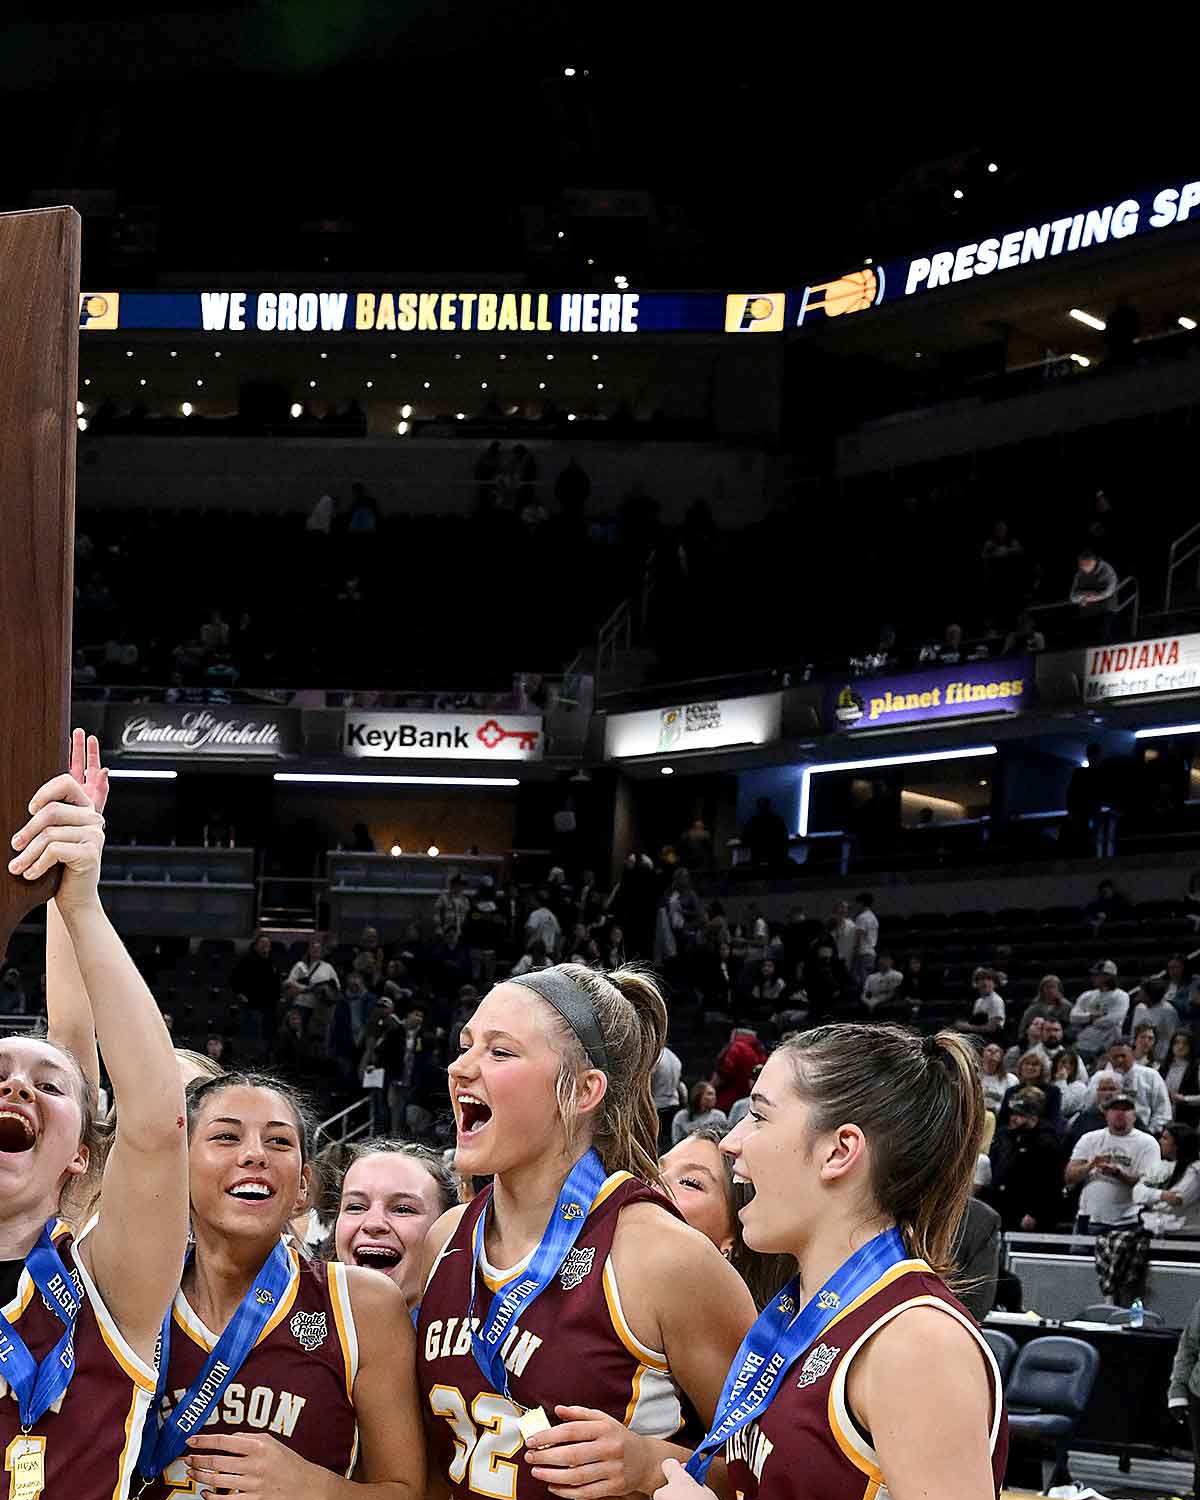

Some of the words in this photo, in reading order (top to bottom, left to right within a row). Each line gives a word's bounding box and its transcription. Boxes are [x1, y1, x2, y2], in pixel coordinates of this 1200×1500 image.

[905, 199, 1140, 295] PRESENTING
[201, 293, 246, 331] WE
[257, 293, 348, 331] GROW
[355, 293, 552, 331] BASKETBALL
[559, 293, 639, 332] HERE
[1089, 640, 1180, 677] INDIANA
[869, 687, 941, 720] planet
[945, 679, 1025, 705] fitness
[347, 723, 469, 751] KeyBank
[486, 1279, 540, 1345] CHAMPION
[176, 1360, 231, 1433] CHAMPION
[708, 1352, 787, 1443] BASKETBALL
